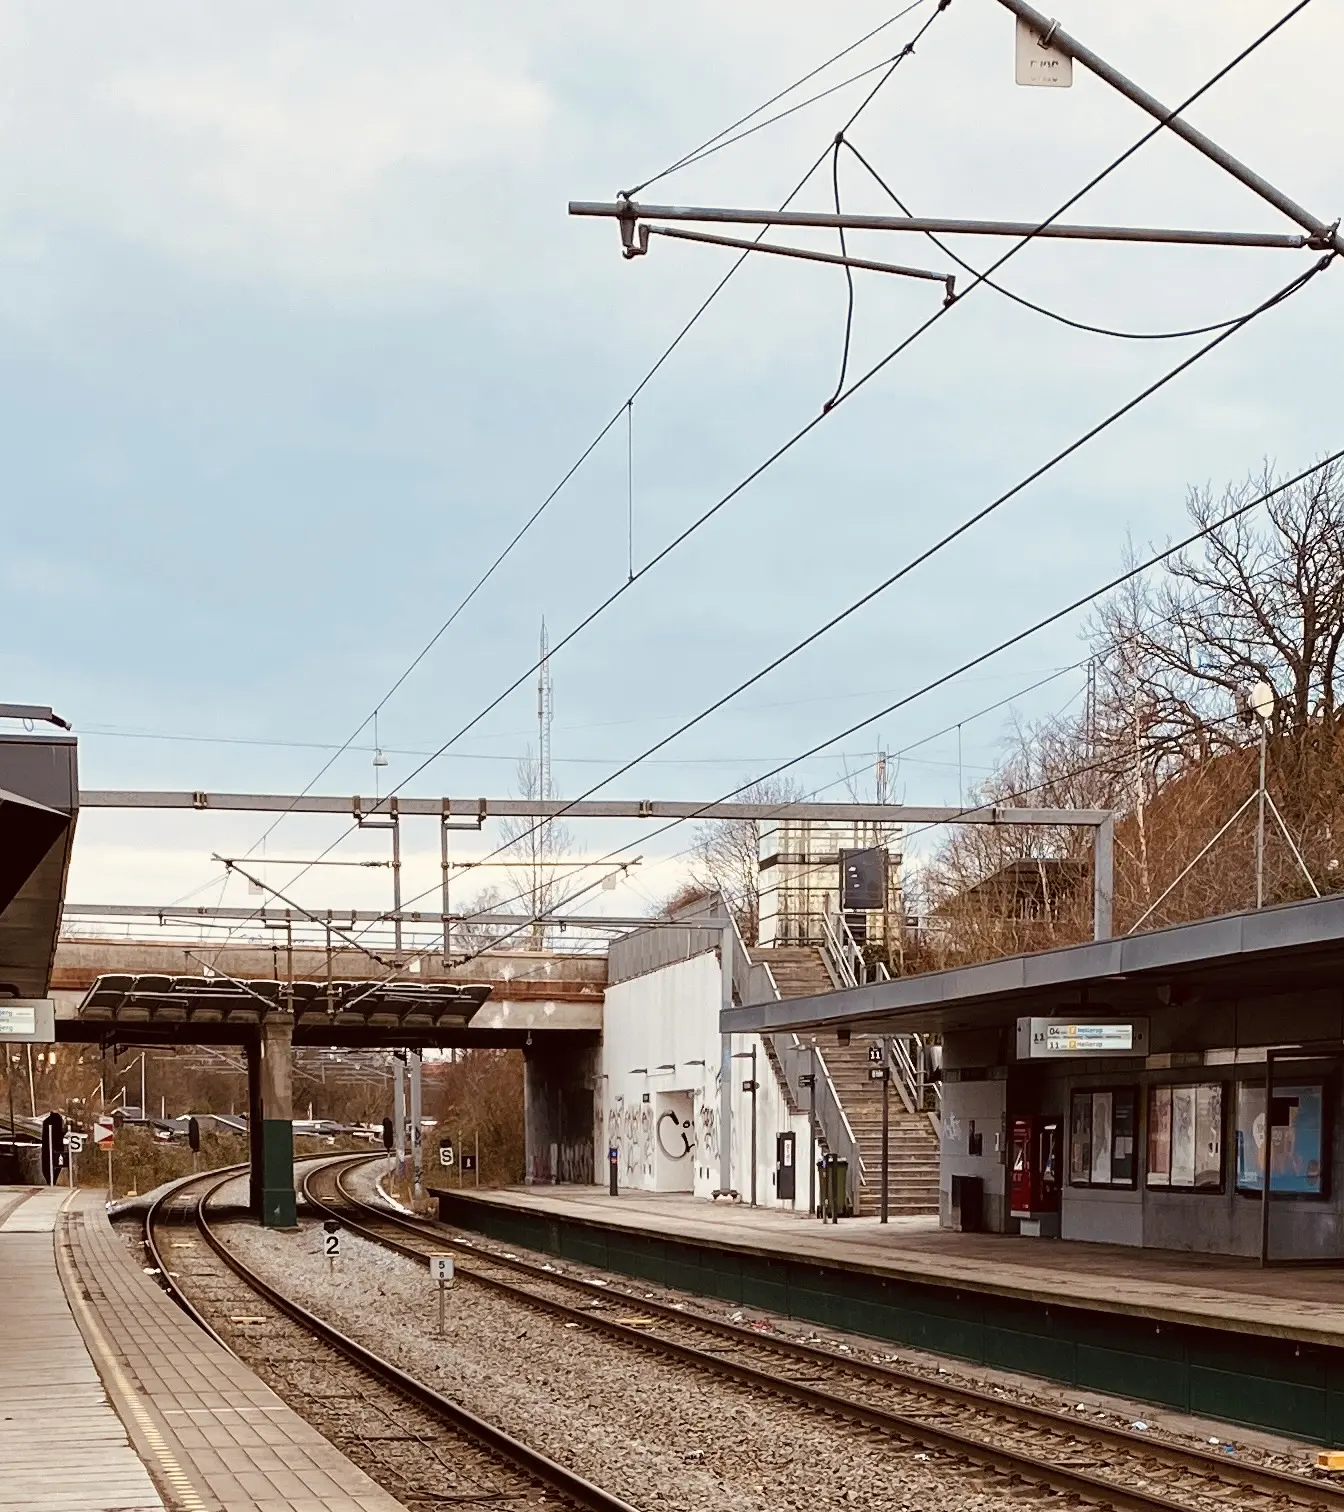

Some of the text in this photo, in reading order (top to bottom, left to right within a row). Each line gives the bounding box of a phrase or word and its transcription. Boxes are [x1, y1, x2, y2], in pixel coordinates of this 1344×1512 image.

[870, 1050, 881, 1060] 11
[70, 1135, 81, 1150] S
[442, 1149, 452, 1163] S
[325, 1236, 340, 1255] 2
[438, 1260, 445, 1269] 5
